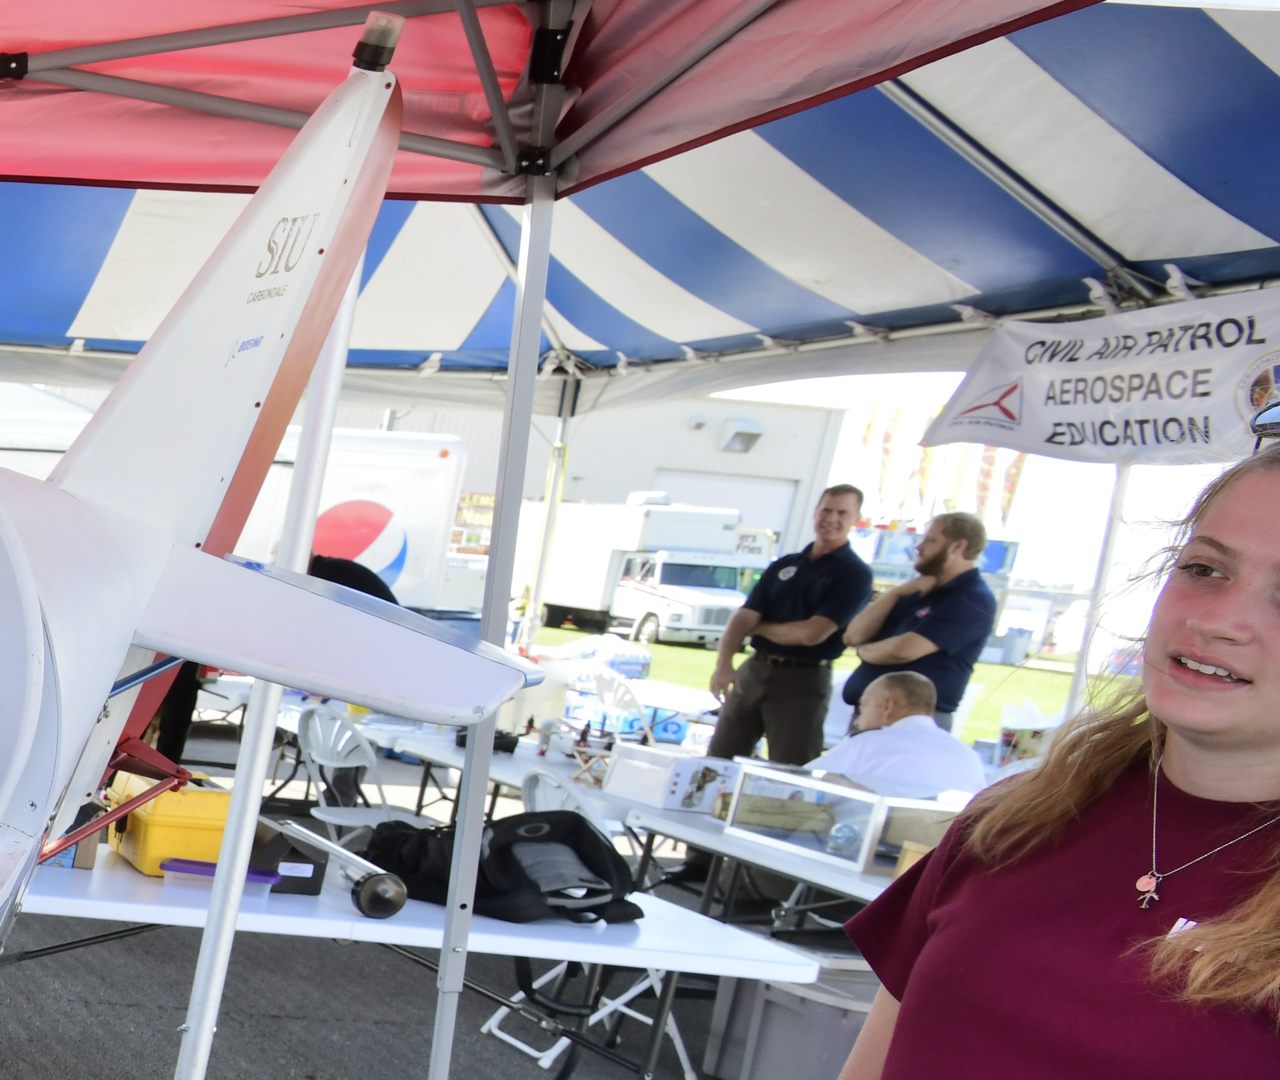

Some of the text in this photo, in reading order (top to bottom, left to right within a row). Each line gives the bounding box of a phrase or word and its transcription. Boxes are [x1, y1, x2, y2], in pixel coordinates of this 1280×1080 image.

[254, 212, 320, 279] SIU
[1024, 315, 1266, 365] CIVIL AIR PATROL
[1044, 367, 1213, 407] AEROSPACE
[1044, 415, 1211, 447] EDUCATION
